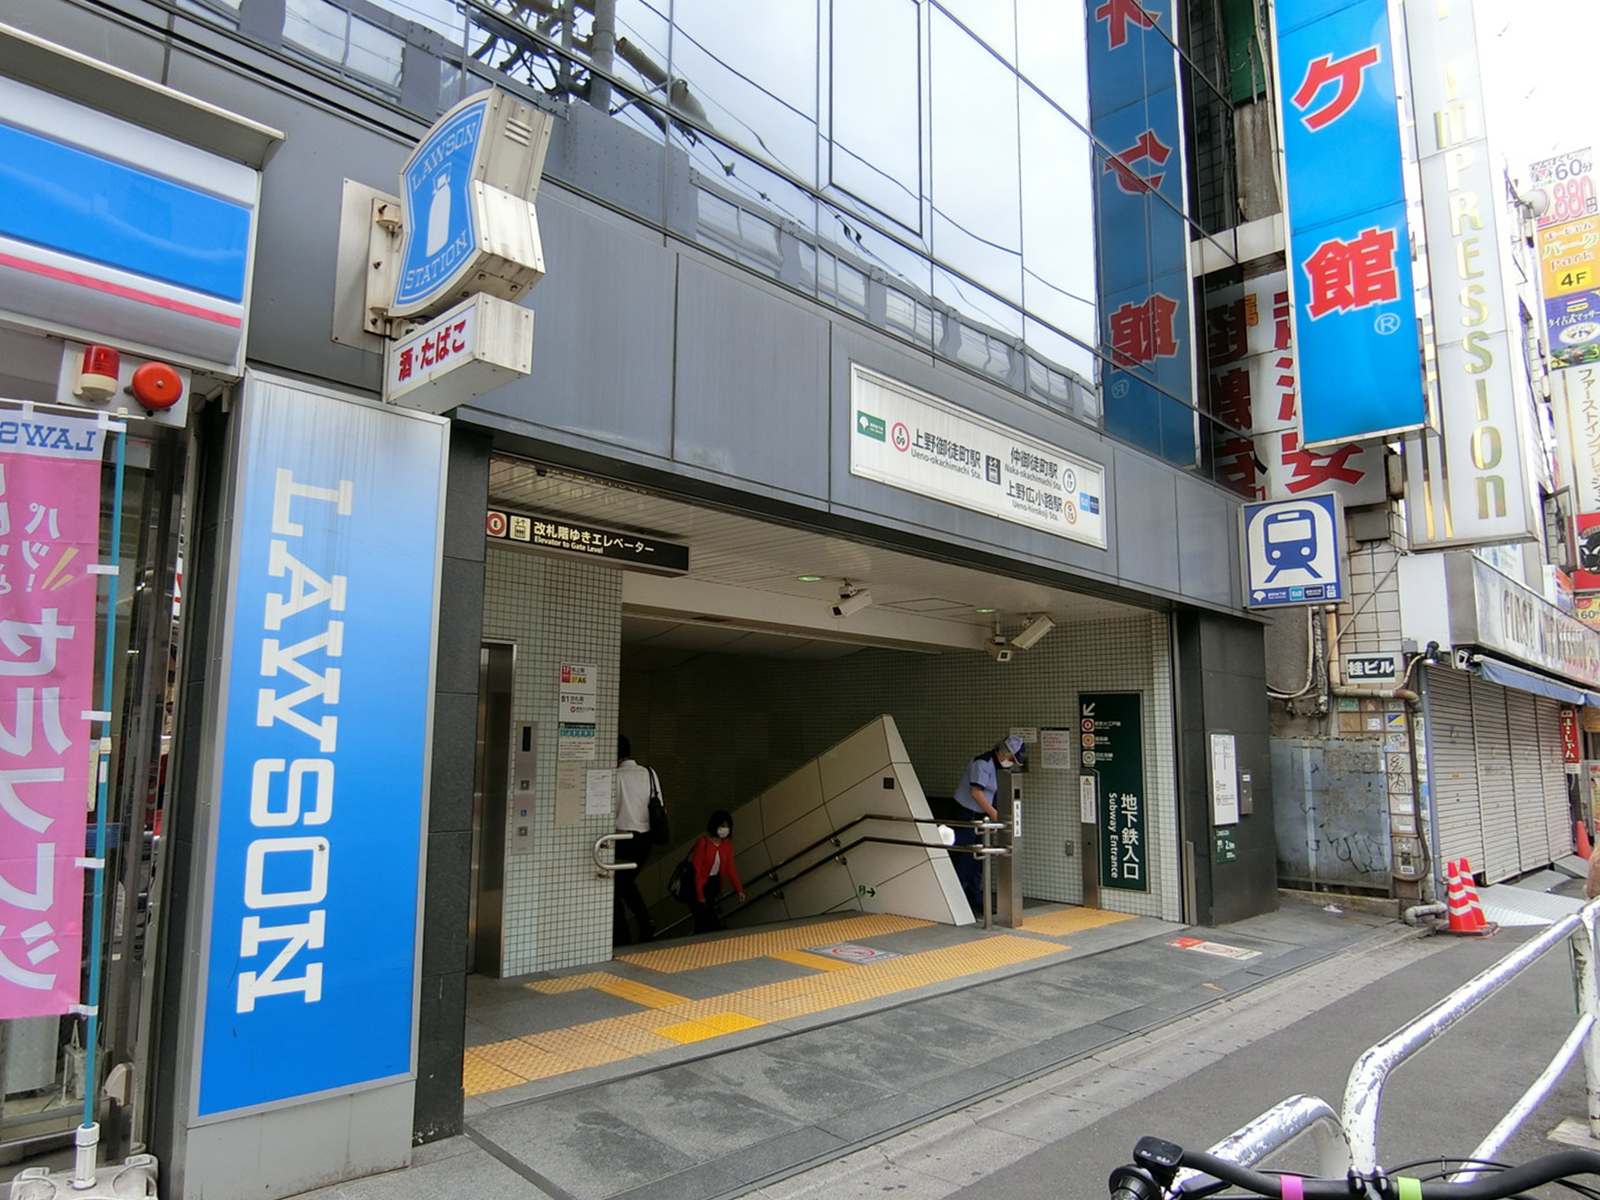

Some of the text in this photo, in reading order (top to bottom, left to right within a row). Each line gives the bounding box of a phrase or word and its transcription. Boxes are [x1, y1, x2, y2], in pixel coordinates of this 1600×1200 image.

[410, 121, 477, 191] LAWSON
[405, 230, 468, 290] STATION
[1561, 271, 1587, 287] 4F
[896, 435, 906, 447] 09
[912, 428, 981, 468] 上野御徒町駅
[911, 448, 970, 478] Ueno-okachimachi
[1004, 464, 1053, 489] Naka-okachimachi
[1010, 446, 1058, 479] 仲御徒町駅
[1006, 480, 1063, 513] 上野広小路駅
[1012, 500, 1048, 520] Ueno-hirokoji
[533, 521, 655, 553] 改札階ゆきエレベーター
[534, 535, 604, 555] Elevator to Gate Level
[236, 468, 353, 1013] LAWSON
[1108, 792, 1118, 879] Subway Entrance
[1121, 793, 1139, 880] 地下鉄入口
